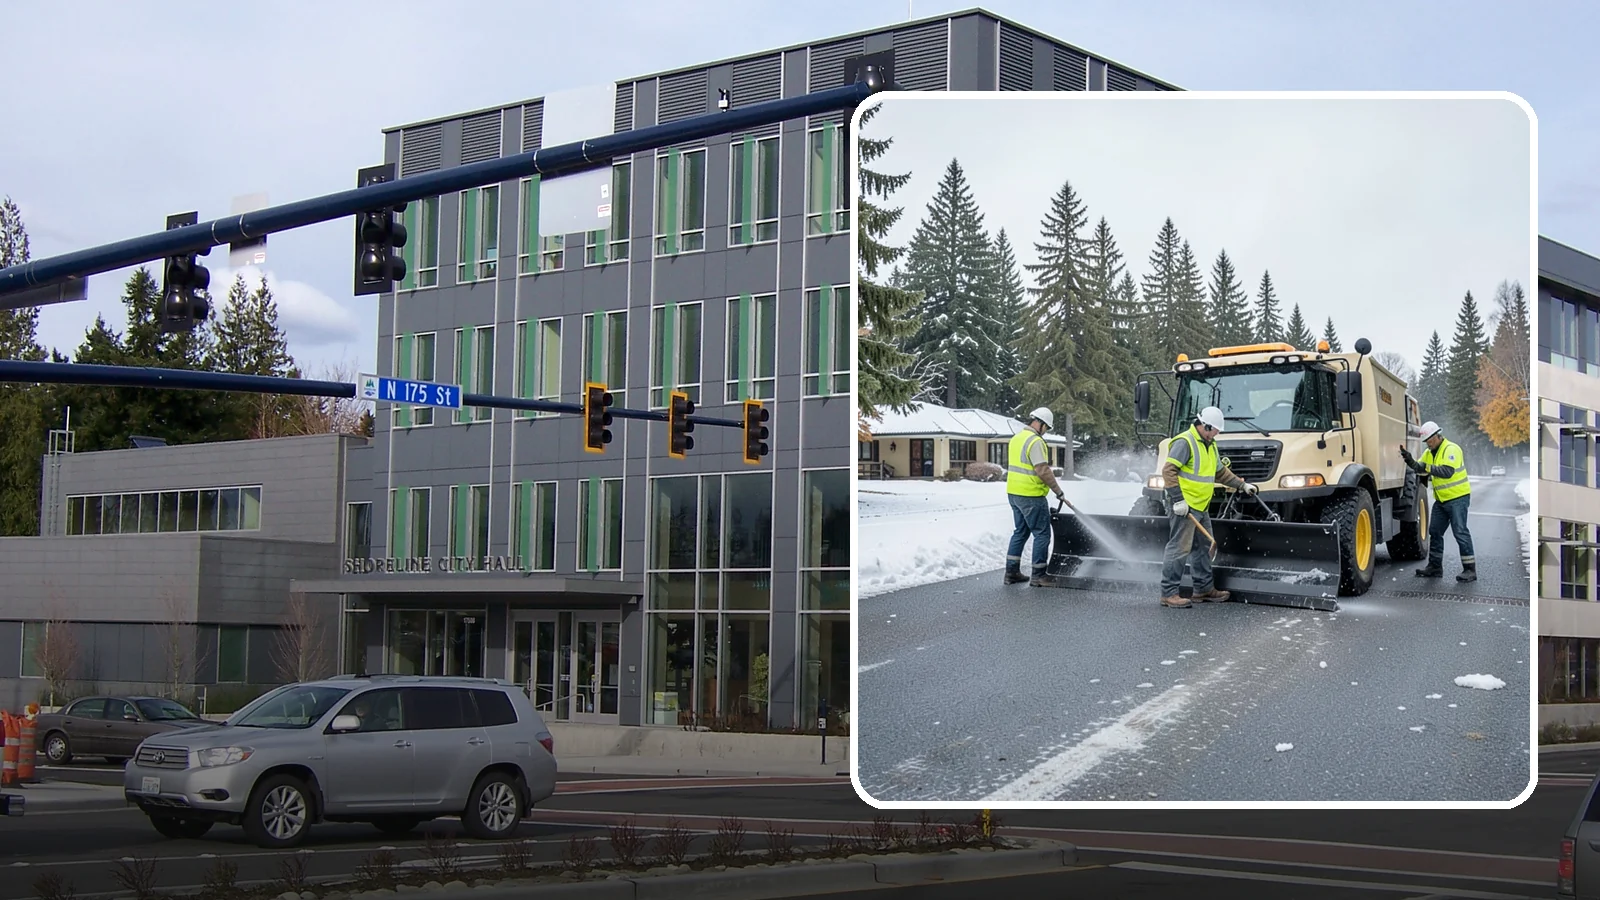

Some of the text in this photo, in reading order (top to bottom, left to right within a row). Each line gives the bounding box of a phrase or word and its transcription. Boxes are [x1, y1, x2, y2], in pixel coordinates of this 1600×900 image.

[387, 381, 451, 405] N 175 St
[344, 556, 525, 573] SHORELINE CITY HALL
